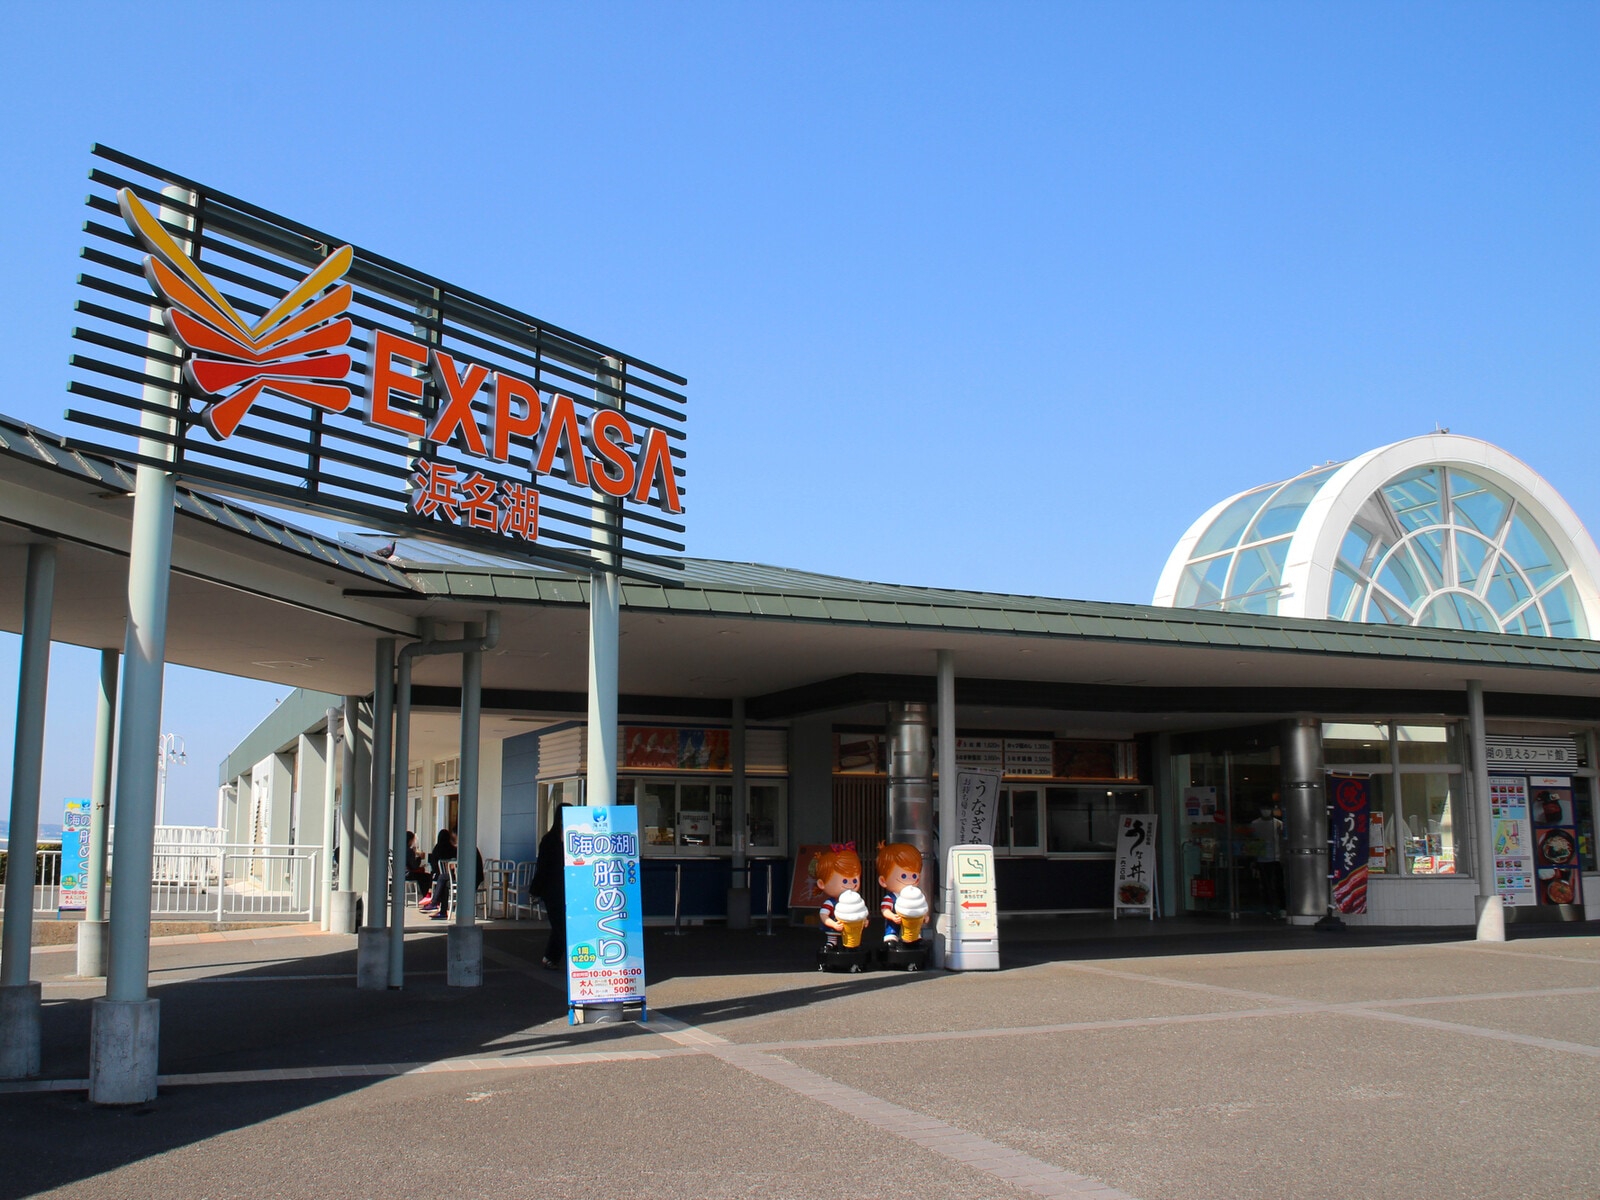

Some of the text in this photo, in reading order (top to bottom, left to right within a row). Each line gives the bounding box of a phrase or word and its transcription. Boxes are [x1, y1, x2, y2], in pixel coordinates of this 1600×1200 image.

[364, 328, 682, 514] EXPASA
[408, 457, 540, 541] 浜名湖
[568, 834, 635, 856] 「海の湖」
[1340, 812, 1359, 871] うなぎ
[595, 861, 627, 964] 船めぐり
[580, 988, 594, 996] 小人
